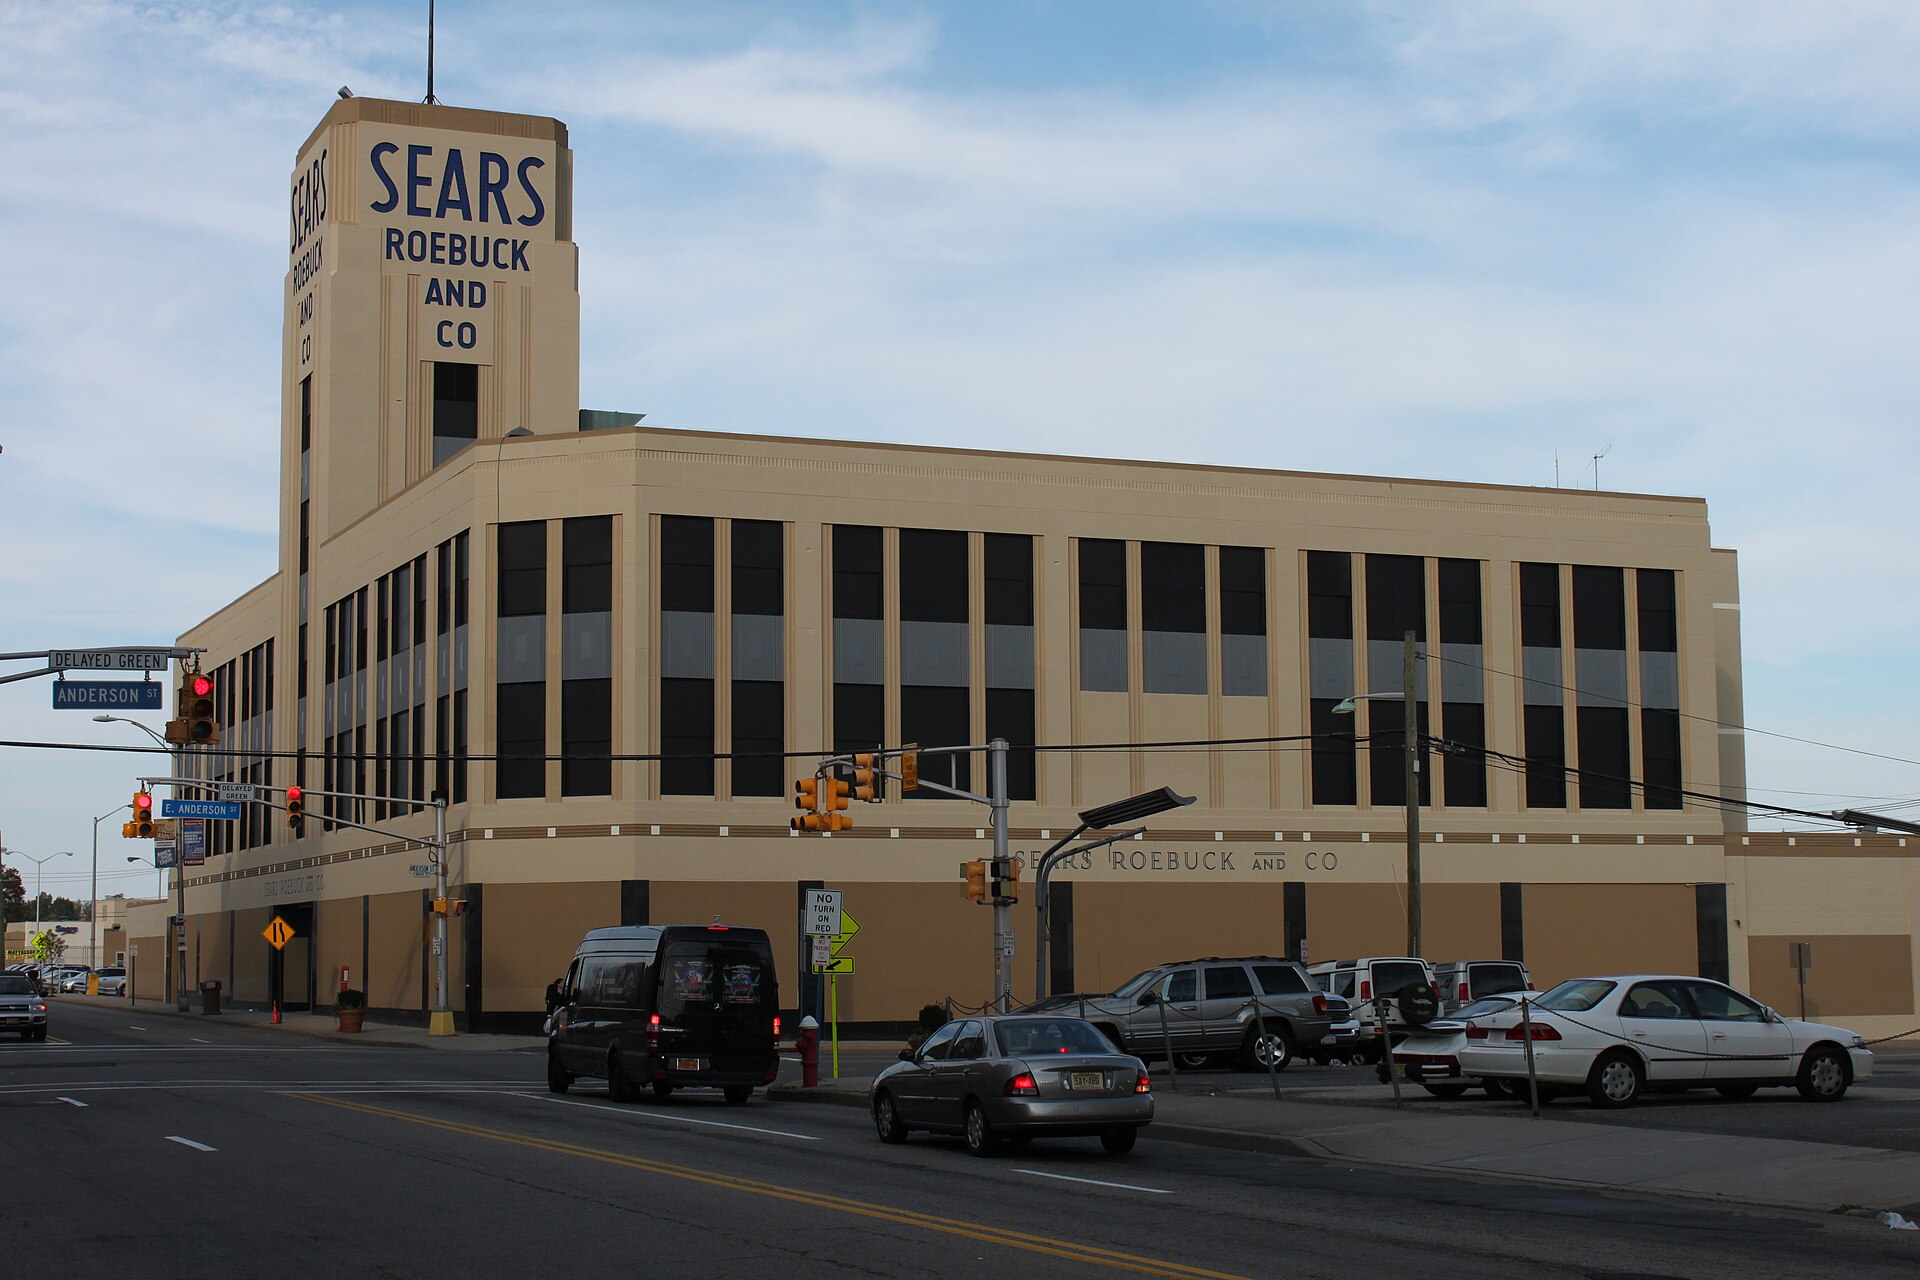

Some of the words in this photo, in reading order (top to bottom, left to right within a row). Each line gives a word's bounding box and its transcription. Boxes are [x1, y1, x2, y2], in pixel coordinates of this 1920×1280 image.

[370, 141, 546, 227] SEARS
[291, 148, 328, 255] SEARS
[385, 227, 531, 272] ROEBUCK
[293, 235, 323, 296] ROEBUCK
[424, 277, 487, 309] AND
[299, 292, 313, 329] AND
[436, 319, 477, 350] CO
[301, 334, 311, 366] CO
[55, 652, 111, 668] DELAYED
[119, 654, 160, 668] GREEN
[57, 687, 139, 703] ANDERSON
[147, 688, 158, 698] ST
[165, 803, 174, 813] E.
[178, 804, 226, 815] ANDERSON
[1112, 851, 1236, 870] ROEBUCK
[1252, 858, 1287, 870] AND
[813, 904, 835, 913] TURN
[817, 894, 833, 903] NO
[815, 924, 831, 932] RED
[818, 915, 829, 923] ON
